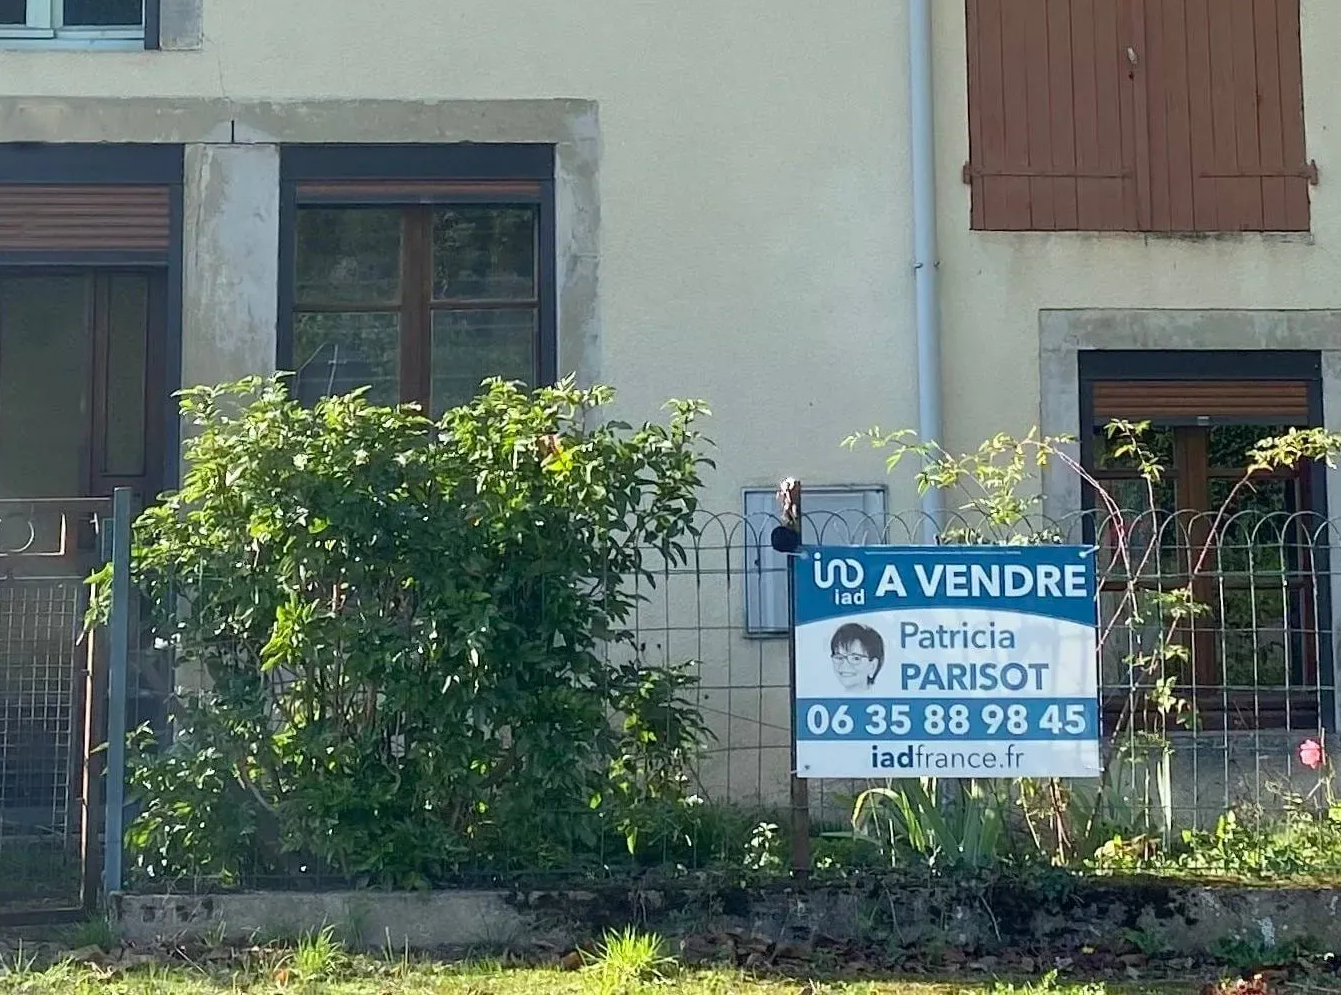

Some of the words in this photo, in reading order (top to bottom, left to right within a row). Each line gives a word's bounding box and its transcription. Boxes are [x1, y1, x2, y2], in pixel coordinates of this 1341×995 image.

[875, 565, 907, 597] A
[913, 564, 1088, 598] VENDRE
[834, 589, 865, 605] iad
[900, 621, 1015, 649] Patricia
[900, 663, 1049, 691] PARISOT
[807, 704, 854, 735] 06
[865, 704, 911, 735] 35
[924, 704, 970, 735] 88
[981, 704, 1028, 735] 98
[1039, 704, 1086, 735] 45
[871, 744, 1025, 769] iadfrance.fr
